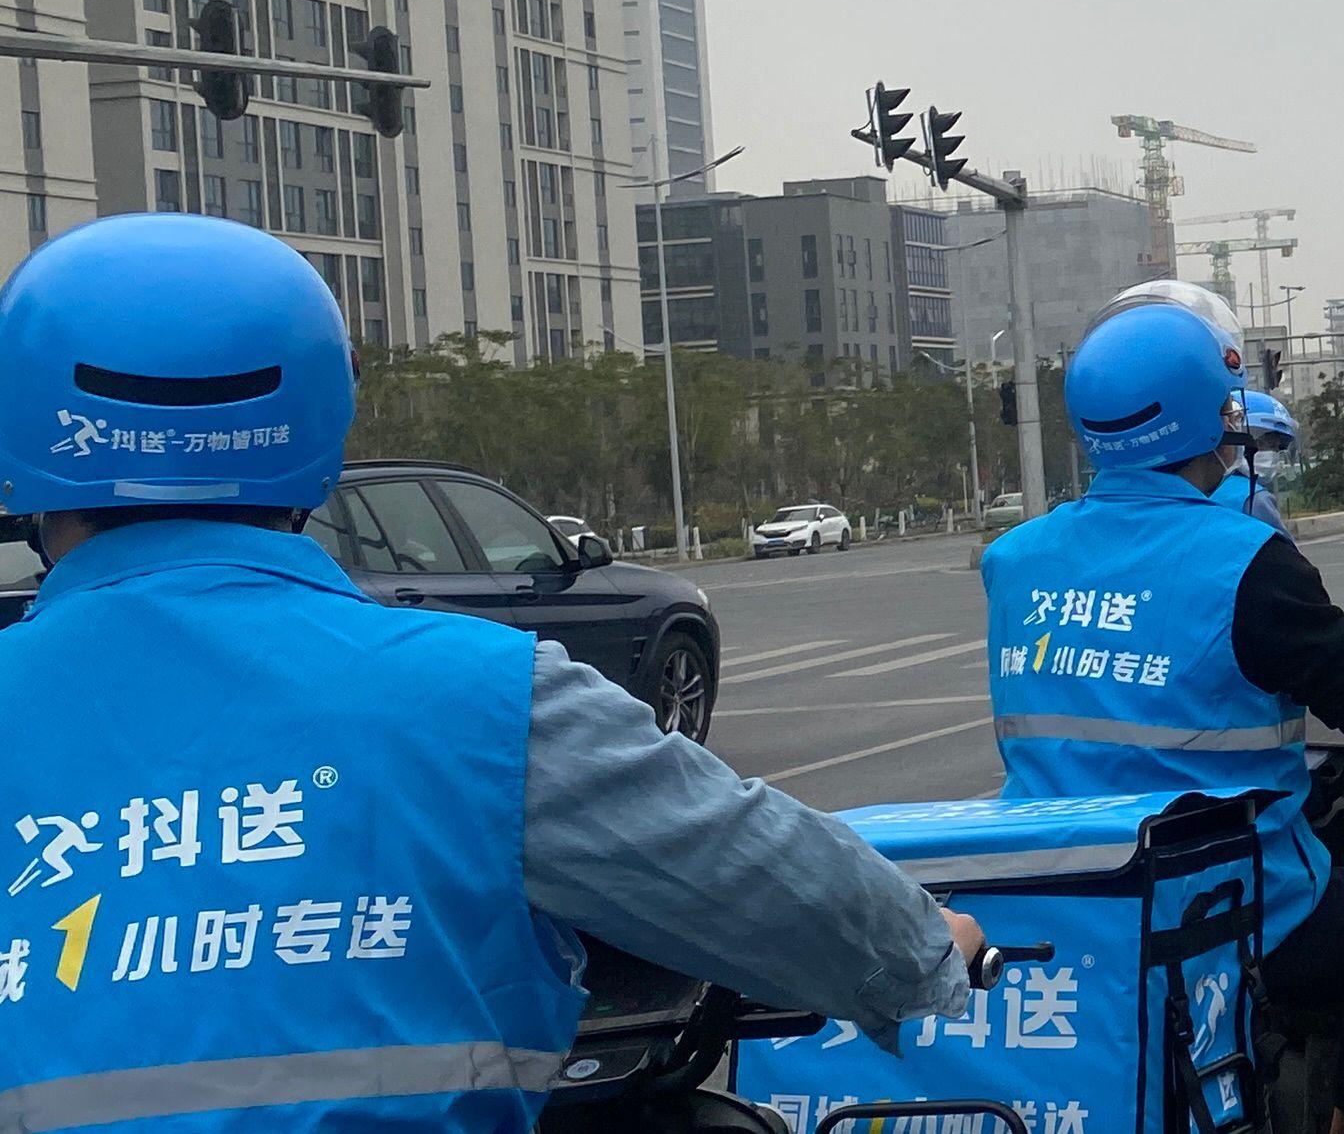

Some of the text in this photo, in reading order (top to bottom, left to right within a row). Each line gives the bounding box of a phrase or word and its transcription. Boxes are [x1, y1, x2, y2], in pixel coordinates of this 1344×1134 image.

[1000, 632, 1171, 687] 同城1小时专送
